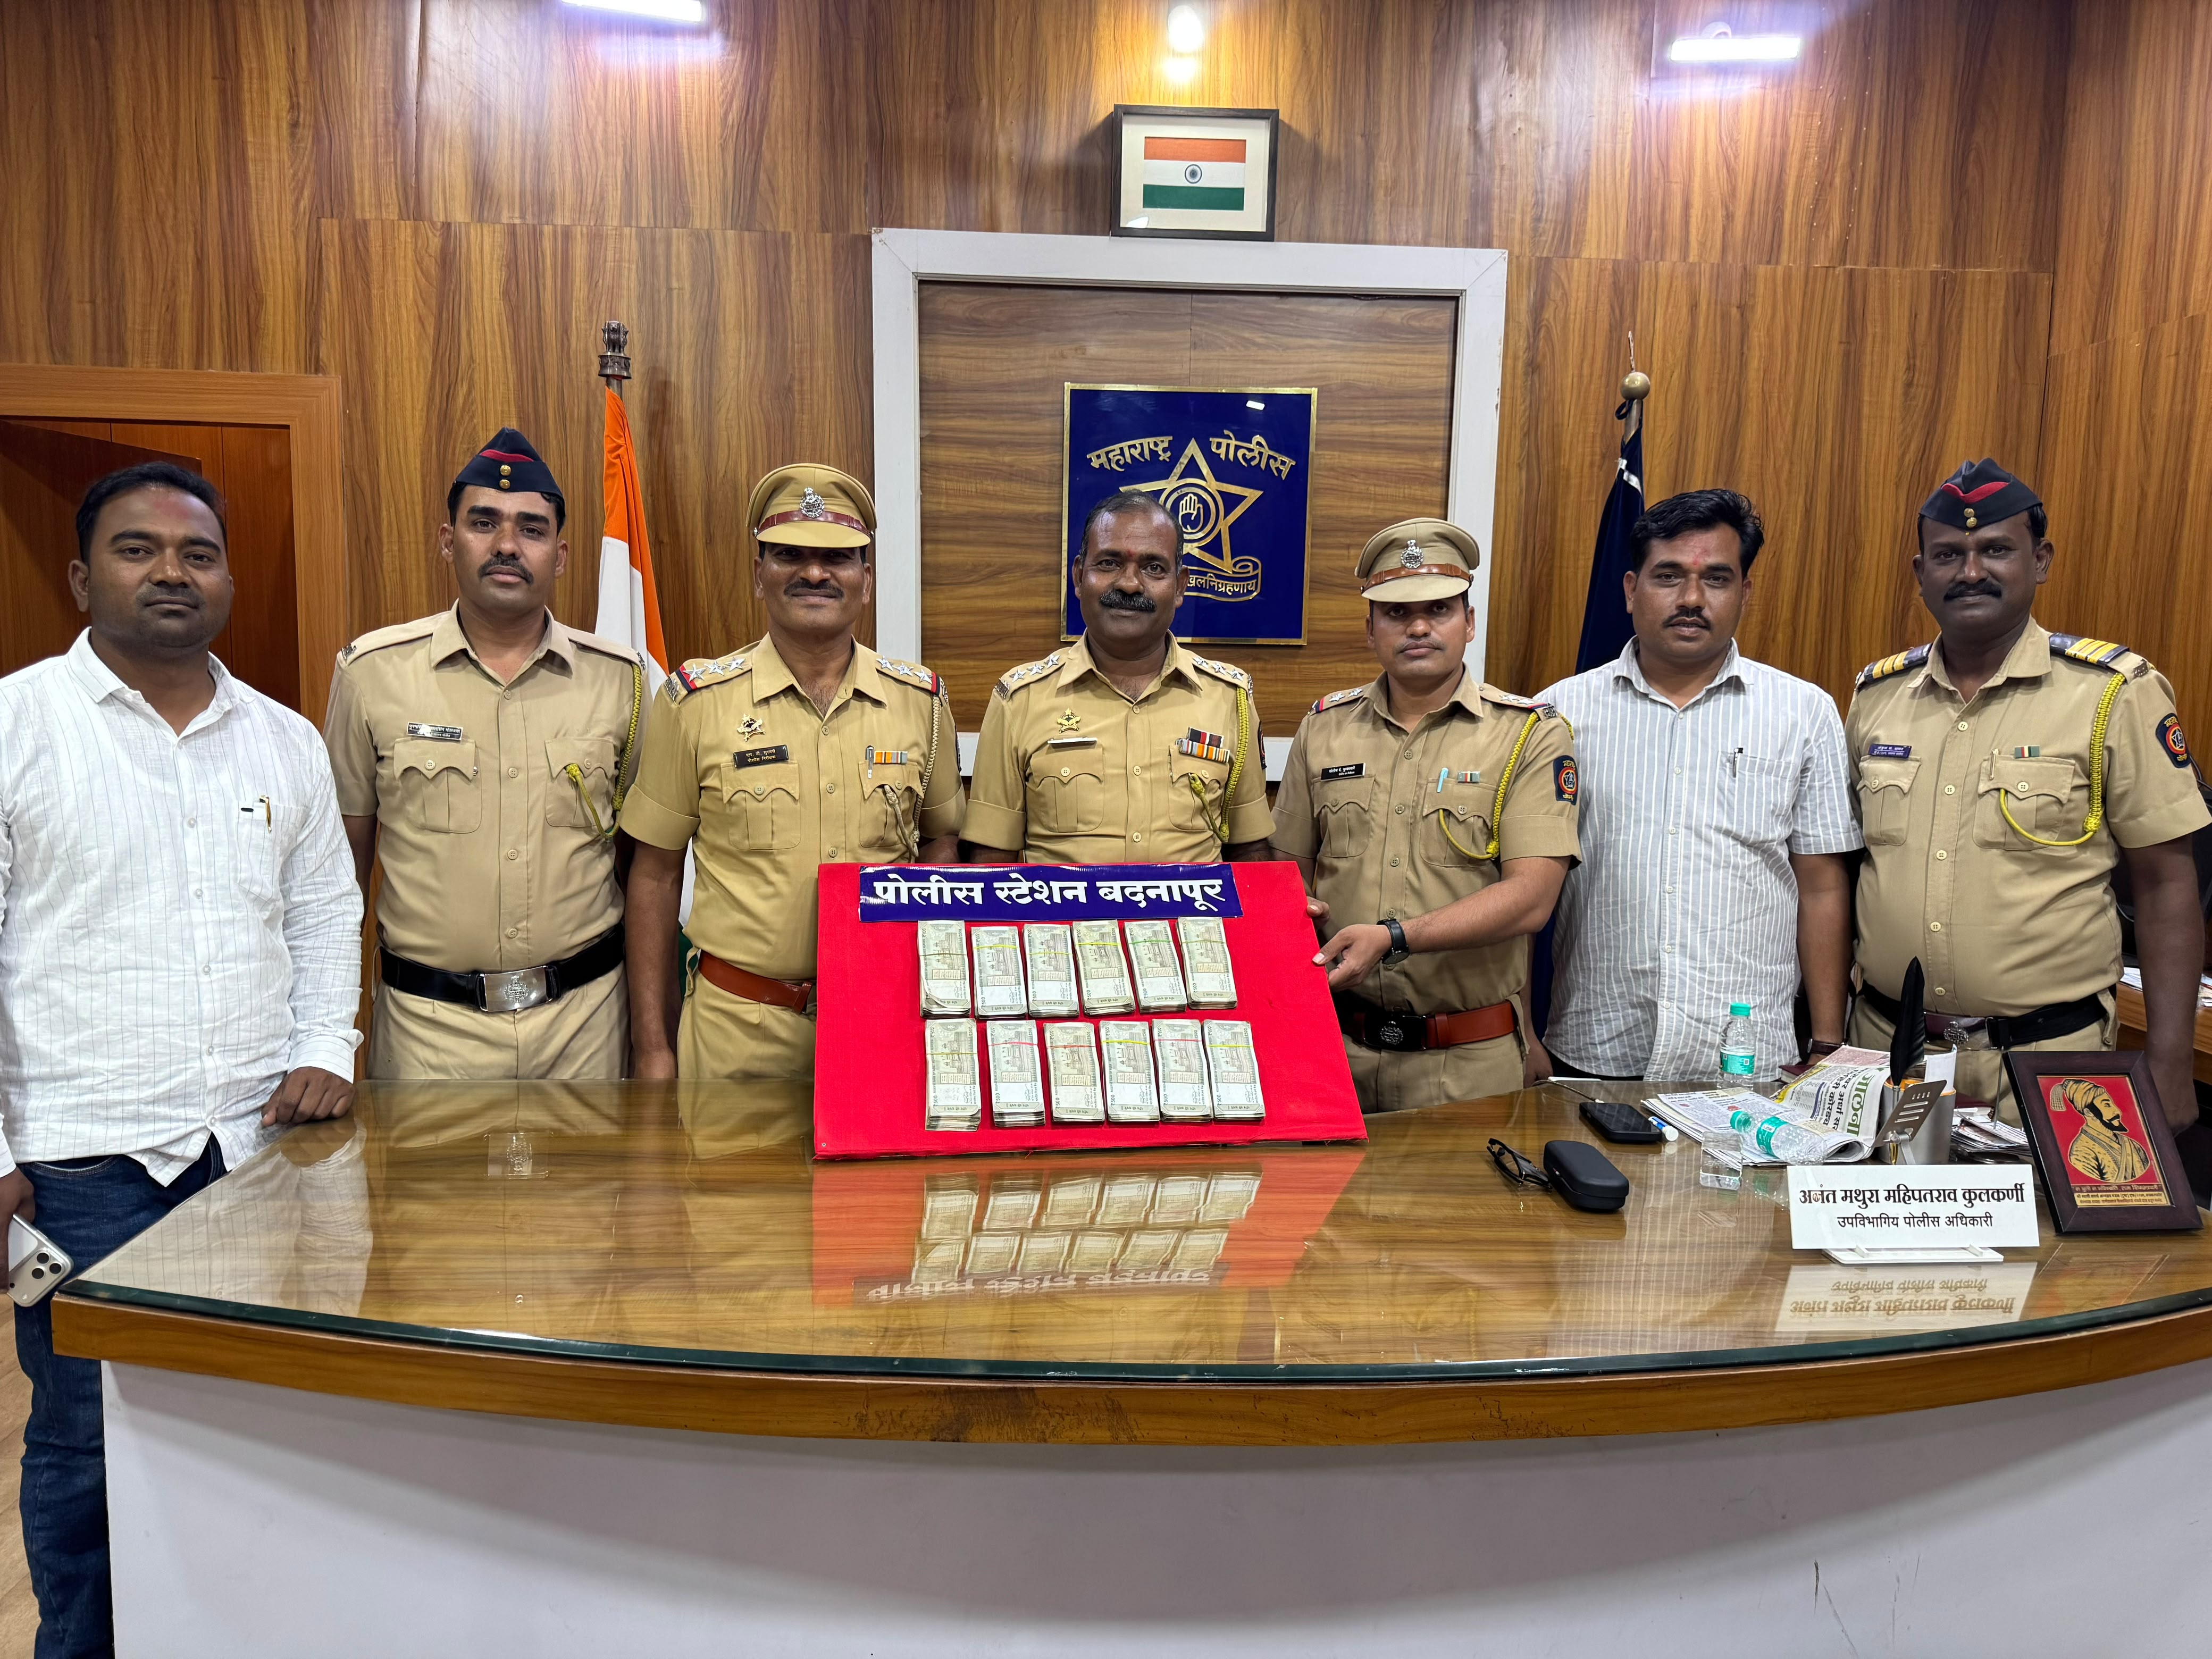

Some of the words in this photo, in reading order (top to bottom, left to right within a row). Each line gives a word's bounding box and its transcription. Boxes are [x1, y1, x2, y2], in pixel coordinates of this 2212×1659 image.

[1086, 435, 1173, 472] महाराष्ट्र
[1210, 430, 1296, 480] पोलीस
[873, 874, 983, 906] पोलीस
[993, 873, 1087, 904] स्टेशन
[1096, 879, 1226, 912] बदनापूर
[1847, 1073, 1875, 1137] जालना
[1799, 1184, 1837, 1204] अनंत
[1841, 1189, 1879, 1209] मथुरा
[1884, 1184, 1957, 1208] महिपतराव
[1962, 1183, 2025, 1208] कुलकर्णी
[1838, 1212, 1899, 1228] उपविभागिय
[1903, 1212, 1940, 1228] पोलीस
[1946, 1211, 1993, 1227] अधिकारी
